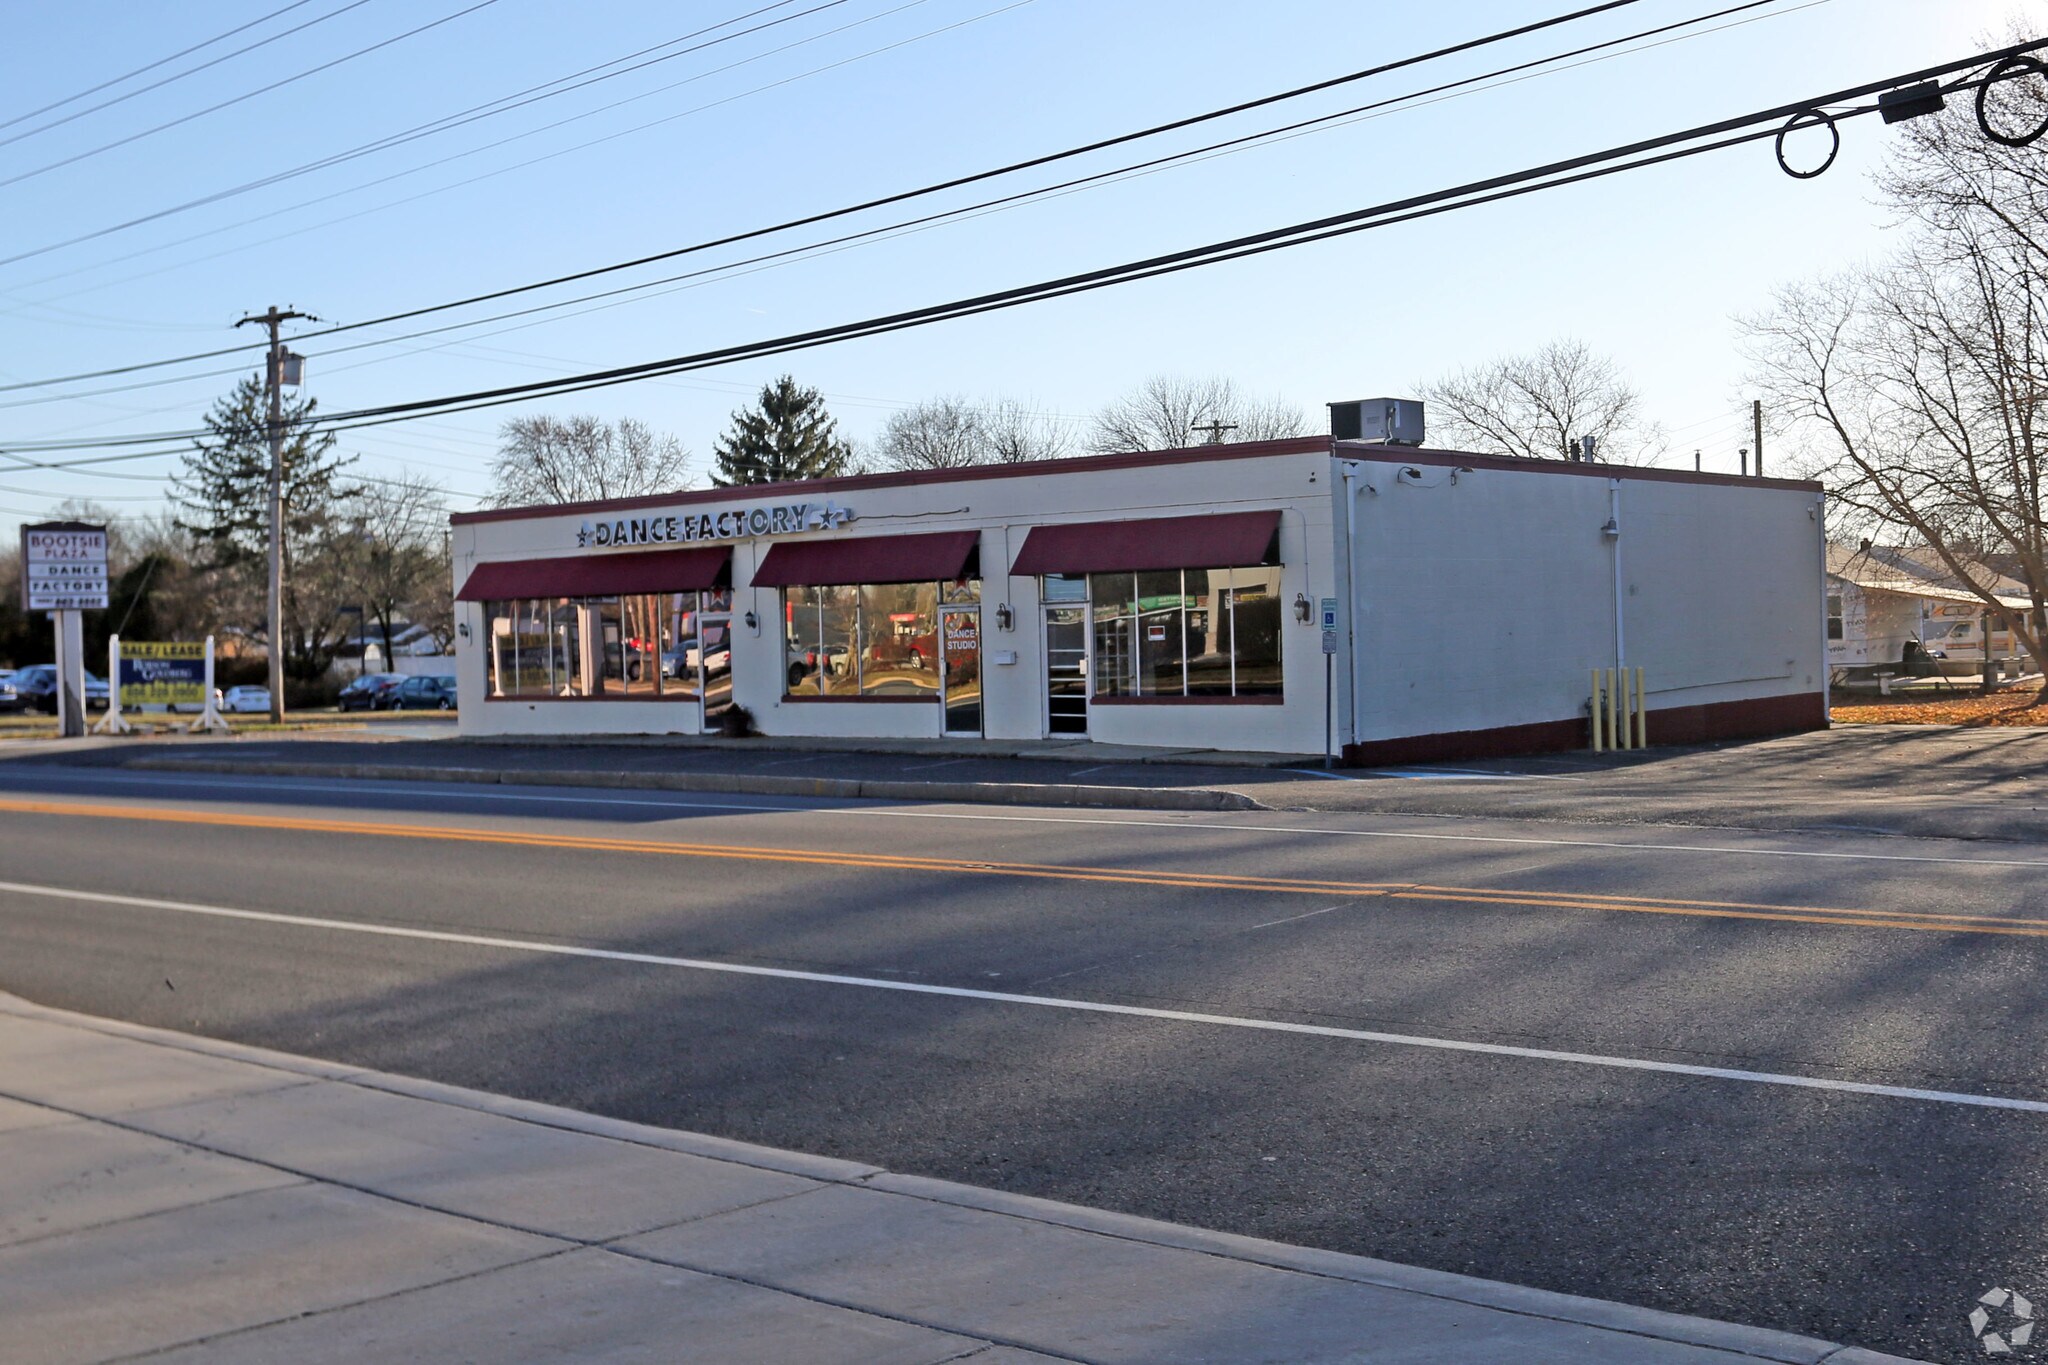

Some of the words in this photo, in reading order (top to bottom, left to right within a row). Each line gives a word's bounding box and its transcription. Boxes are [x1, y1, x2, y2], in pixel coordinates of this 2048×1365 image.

[595, 516, 677, 546] DANCE
[682, 504, 808, 541] FACTORY
[31, 535, 100, 548] BOOTSIE
[45, 549, 88, 558] PLAZA
[49, 566, 99, 575] DANCE
[33, 582, 103, 591] FACTORY
[947, 629, 976, 639] DANCE
[947, 640, 977, 650] STUDIO
